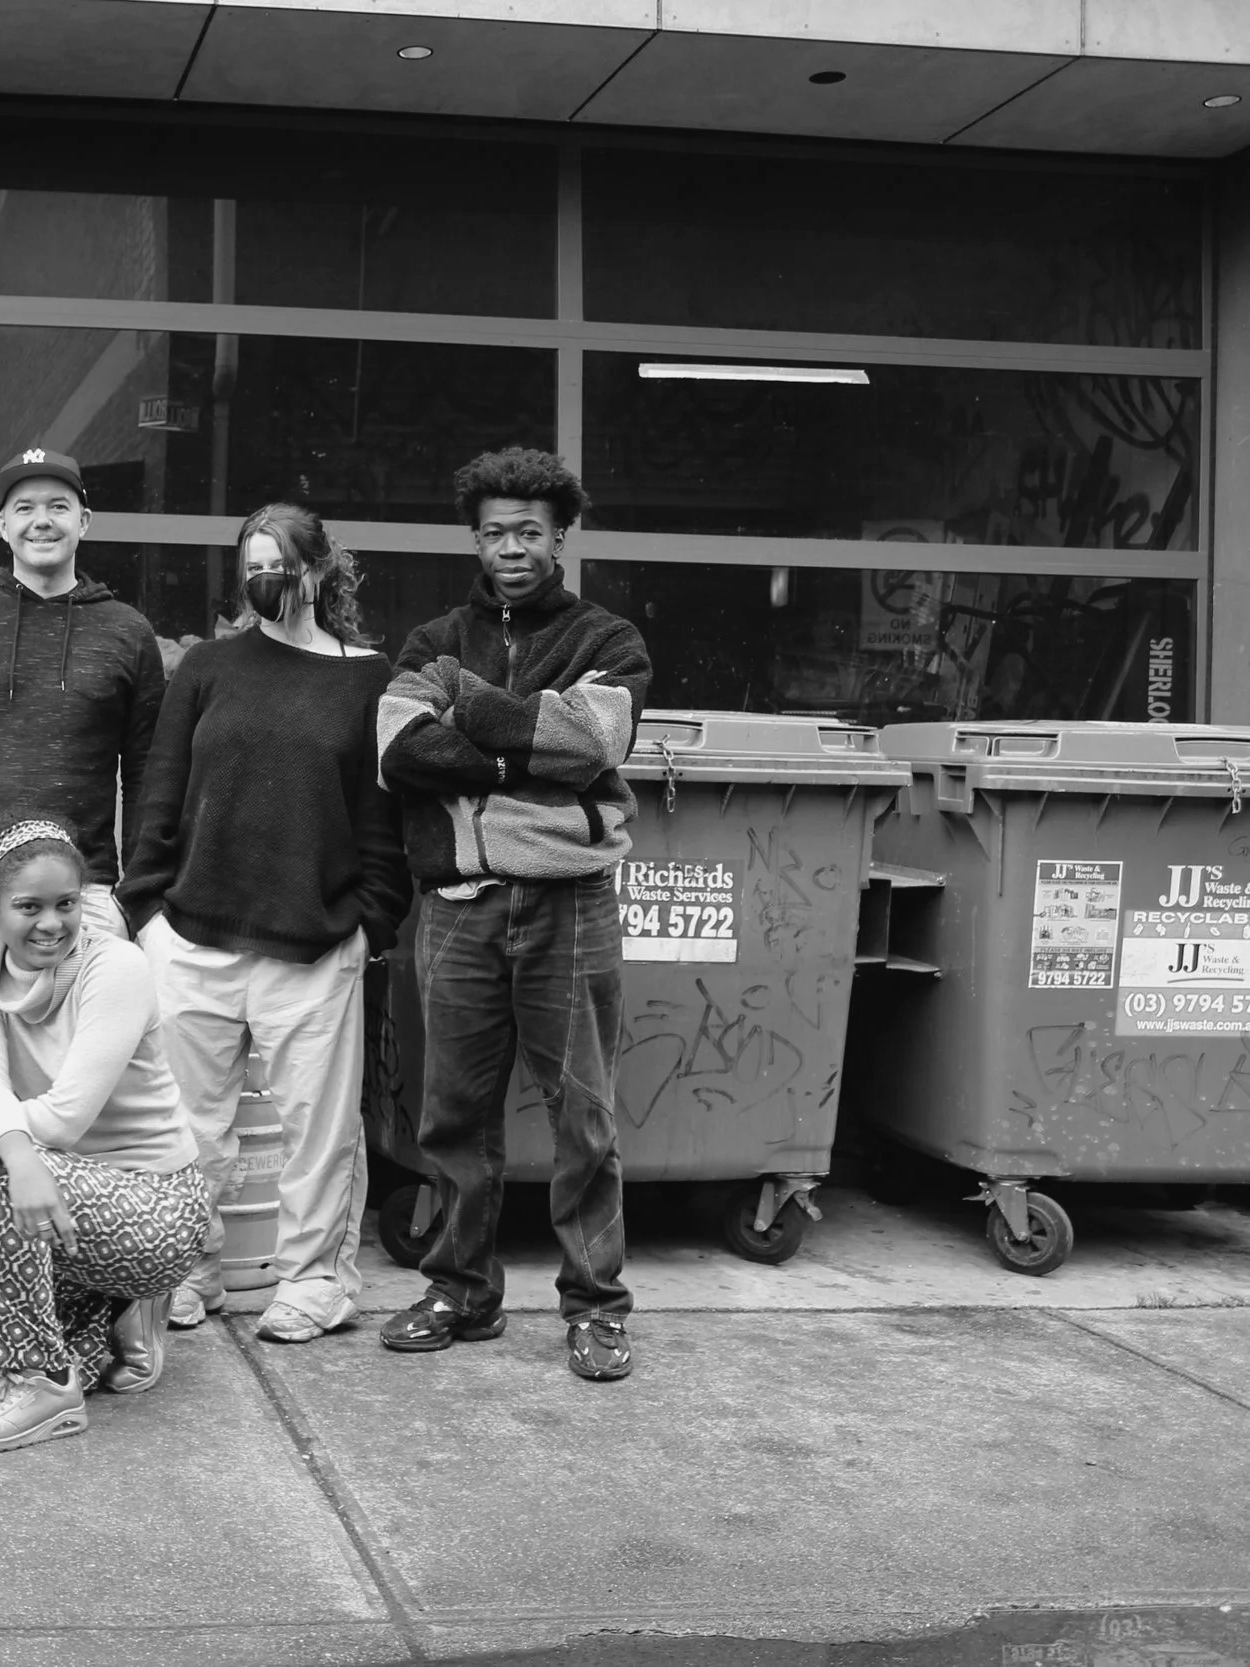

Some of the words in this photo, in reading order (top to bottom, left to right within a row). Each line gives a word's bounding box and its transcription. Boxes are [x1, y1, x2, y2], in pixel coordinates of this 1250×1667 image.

[1147, 637, 1174, 723] SHERLO
[627, 861, 734, 889] Richards
[627, 886, 671, 902] Waste
[673, 886, 733, 903] Services
[1205, 881, 1242, 894] Waste
[668, 905, 734, 938] 5722
[1133, 911, 1249, 924] RECYCLAB
[1203, 955, 1229, 964] Waste
[1232, 955, 1240, 964] &
[1202, 965, 1244, 975] Recycling
[1038, 971, 1070, 985] 9794
[1073, 971, 1106, 985] 5722
[1125, 993, 1166, 1017] (03)
[1173, 994, 1224, 1013] 9794
